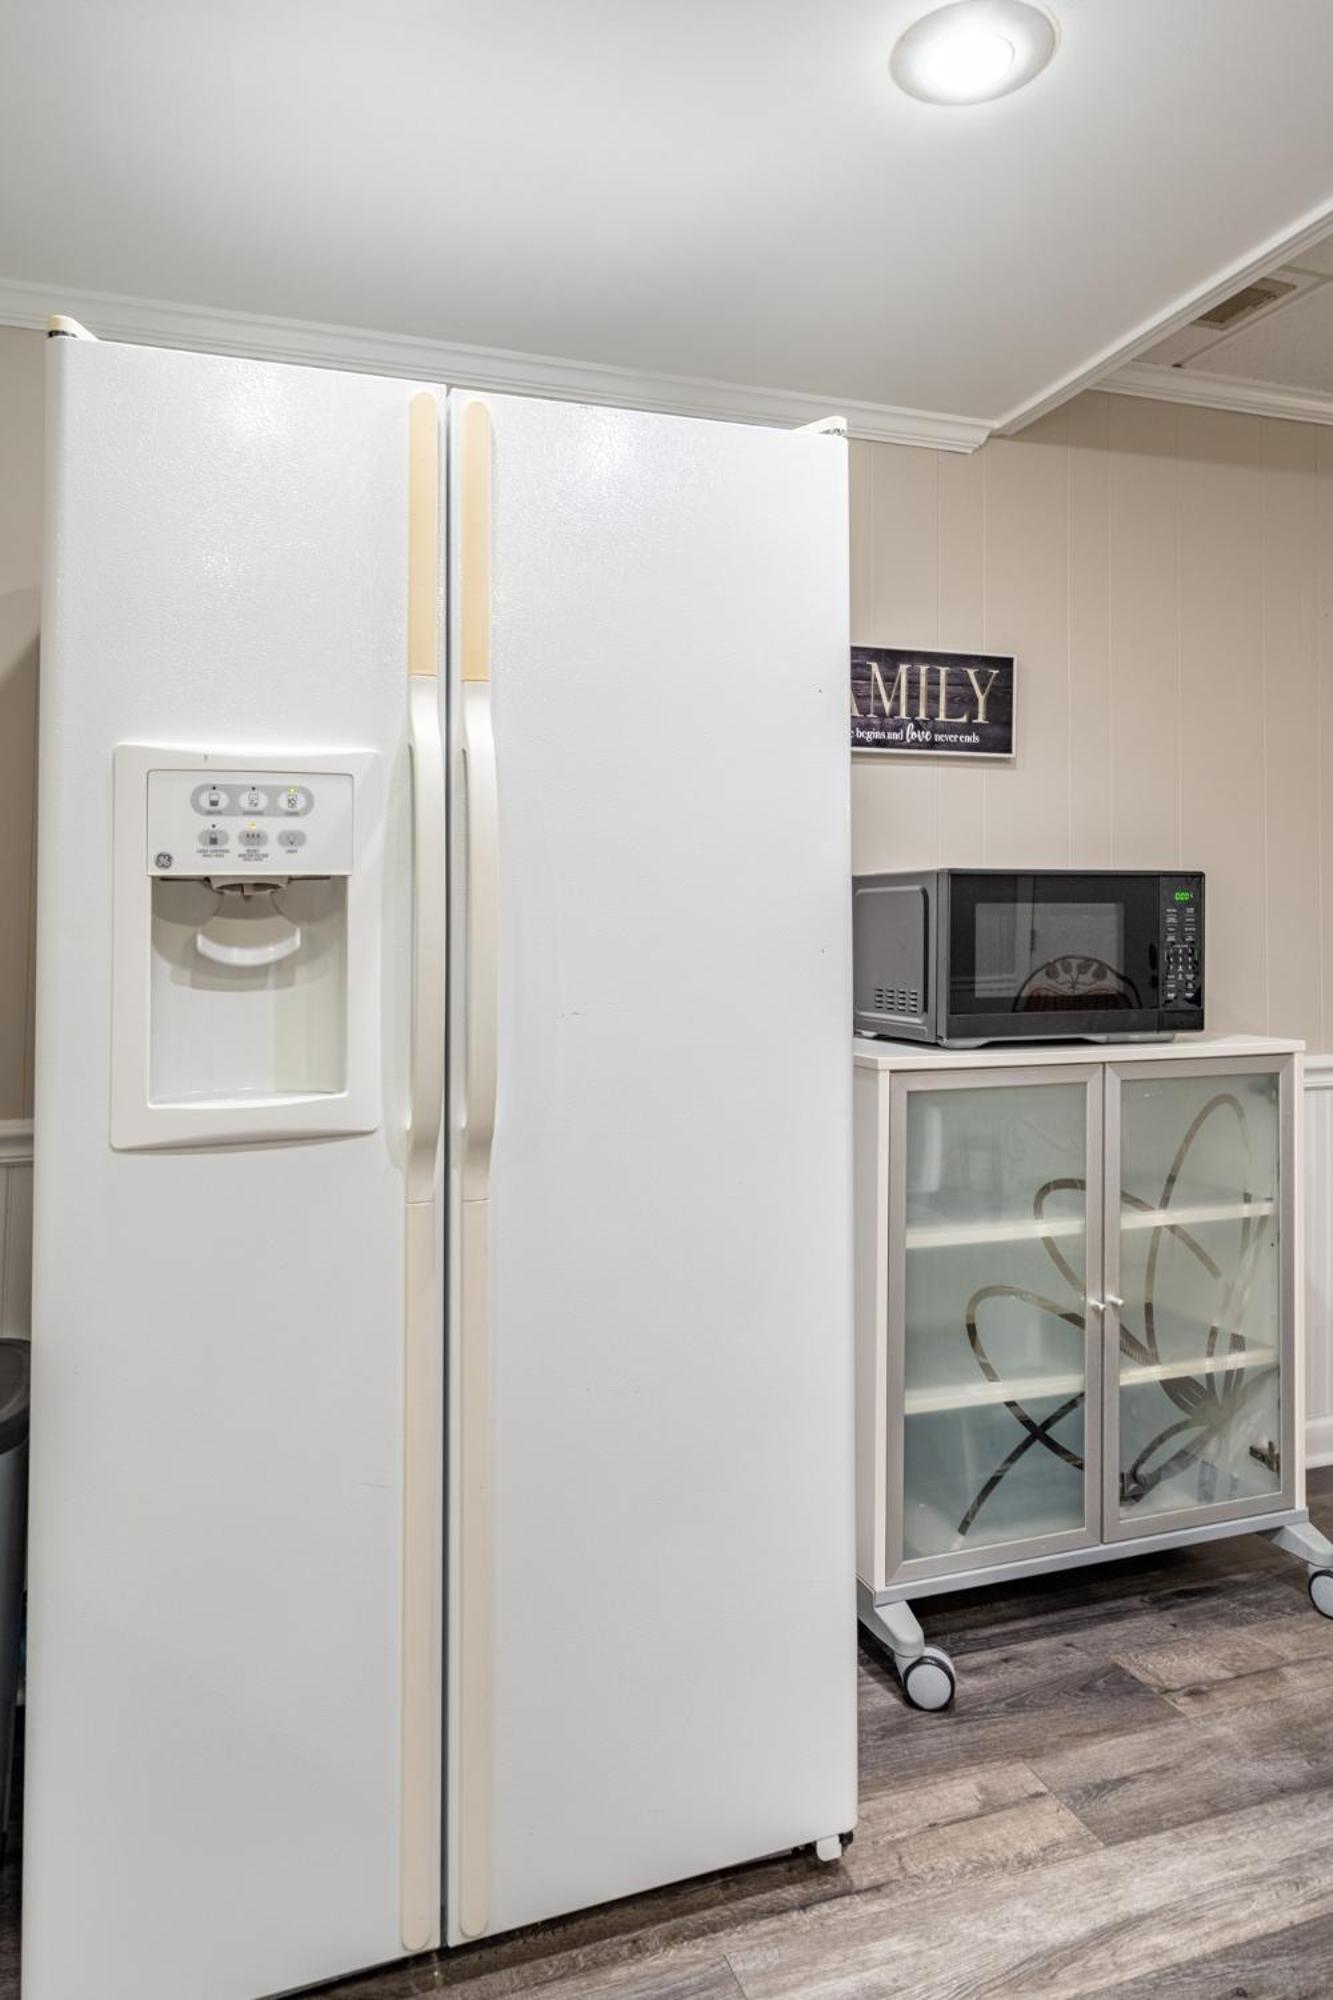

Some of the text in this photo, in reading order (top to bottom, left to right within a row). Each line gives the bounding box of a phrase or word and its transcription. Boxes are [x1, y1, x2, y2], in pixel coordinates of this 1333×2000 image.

[856, 727, 886, 742] begins
[887, 729, 904, 740] and
[906, 722, 932, 743] love
[934, 733, 959, 742] never
[959, 731, 980, 743] ends
